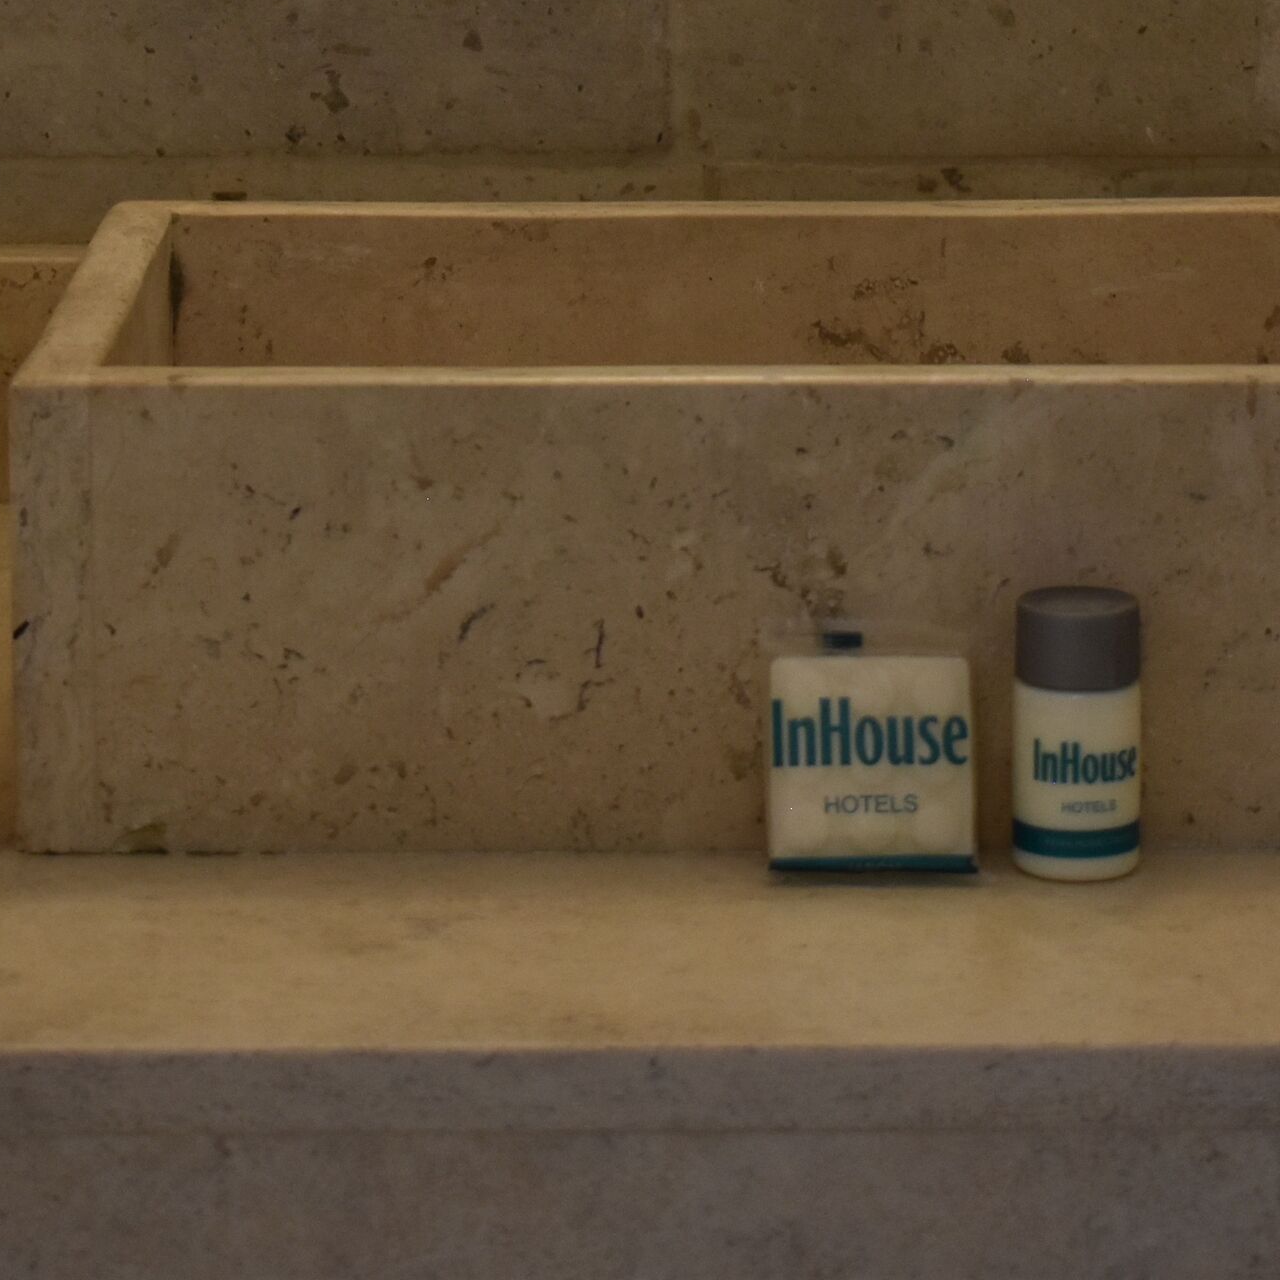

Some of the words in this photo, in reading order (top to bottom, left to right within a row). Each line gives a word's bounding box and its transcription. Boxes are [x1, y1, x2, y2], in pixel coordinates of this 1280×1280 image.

[771, 697, 969, 768] InHouse
[1033, 738, 1137, 784] InHouse
[824, 794, 918, 814] HOTELS
[1061, 799, 1117, 814] HOTELS
